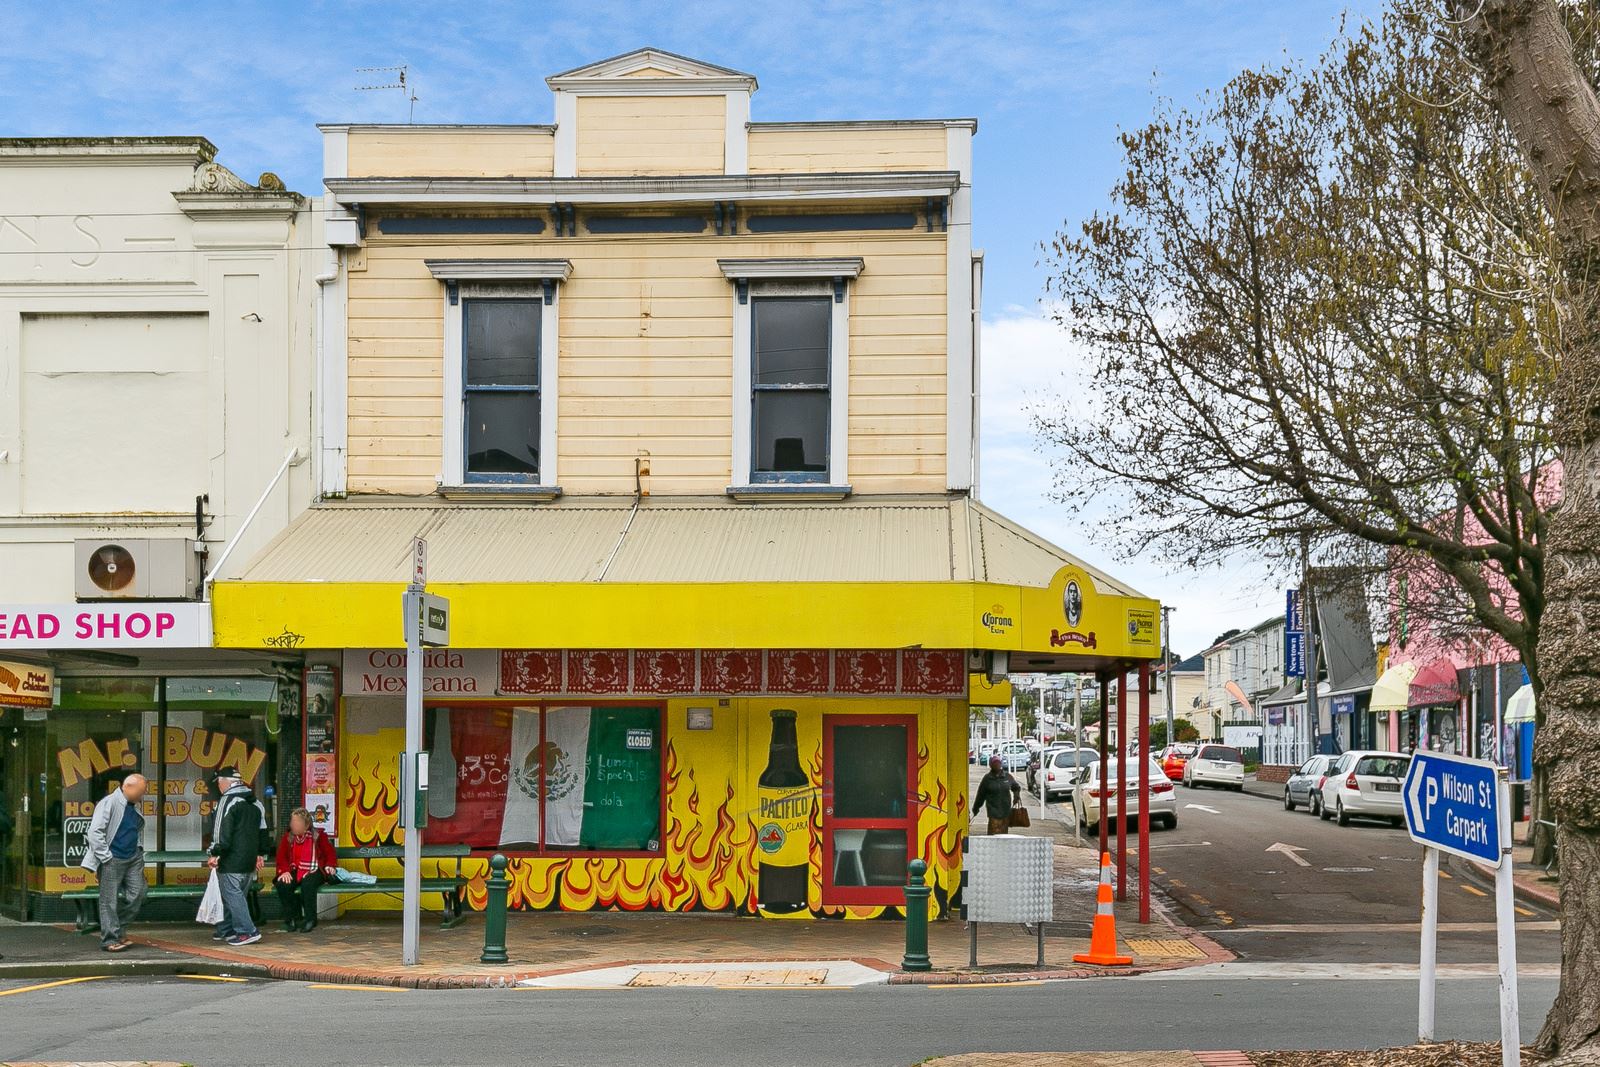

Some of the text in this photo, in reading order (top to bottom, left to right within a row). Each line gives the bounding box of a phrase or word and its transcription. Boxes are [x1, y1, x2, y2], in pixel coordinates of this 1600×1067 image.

[75, 612, 175, 639] SHOP
[982, 612, 1013, 628] Corona
[1289, 637, 1297, 672] Newtown
[1297, 634, 1305, 675] Laundrette
[362, 674, 477, 692] Mexcana
[21, 697, 36, 705] Coffee
[627, 736, 651, 747] CLOSED
[57, 738, 137, 788] Mr.
[192, 780, 210, 796] &
[1442, 772, 1491, 810] Wilson St
[785, 820, 808, 834] CLARA
[1446, 808, 1488, 846] Carpark
[60, 874, 86, 885] Bread
